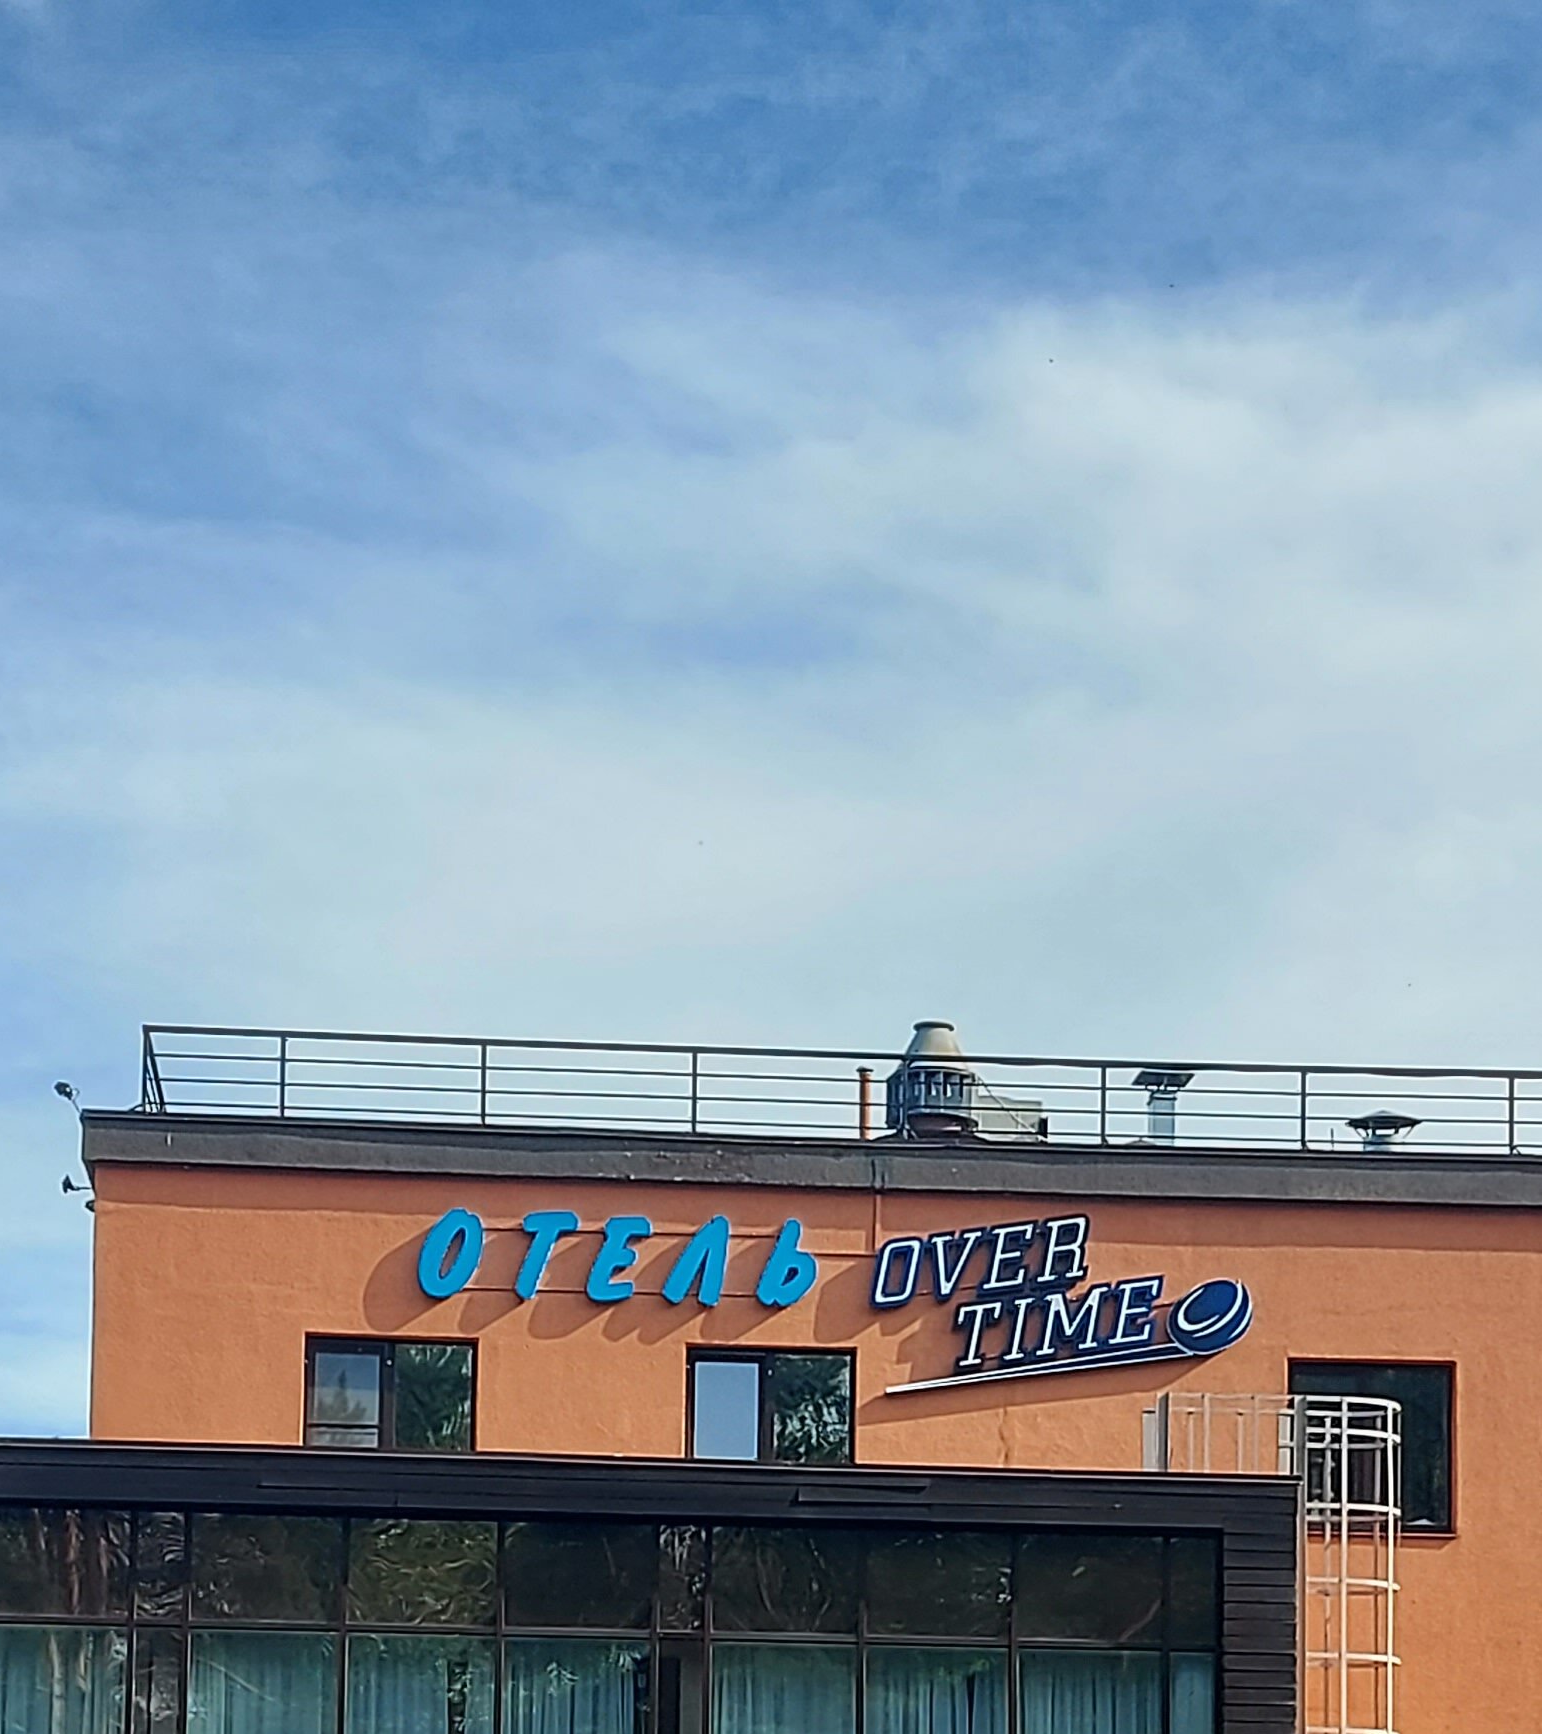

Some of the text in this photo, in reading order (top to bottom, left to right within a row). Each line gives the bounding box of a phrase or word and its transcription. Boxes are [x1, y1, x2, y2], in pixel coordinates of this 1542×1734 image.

[417, 1207, 817, 1307] ОТЕЛЬ
[871, 1214, 1090, 1308] OVER
[955, 1276, 1162, 1368] TIME
